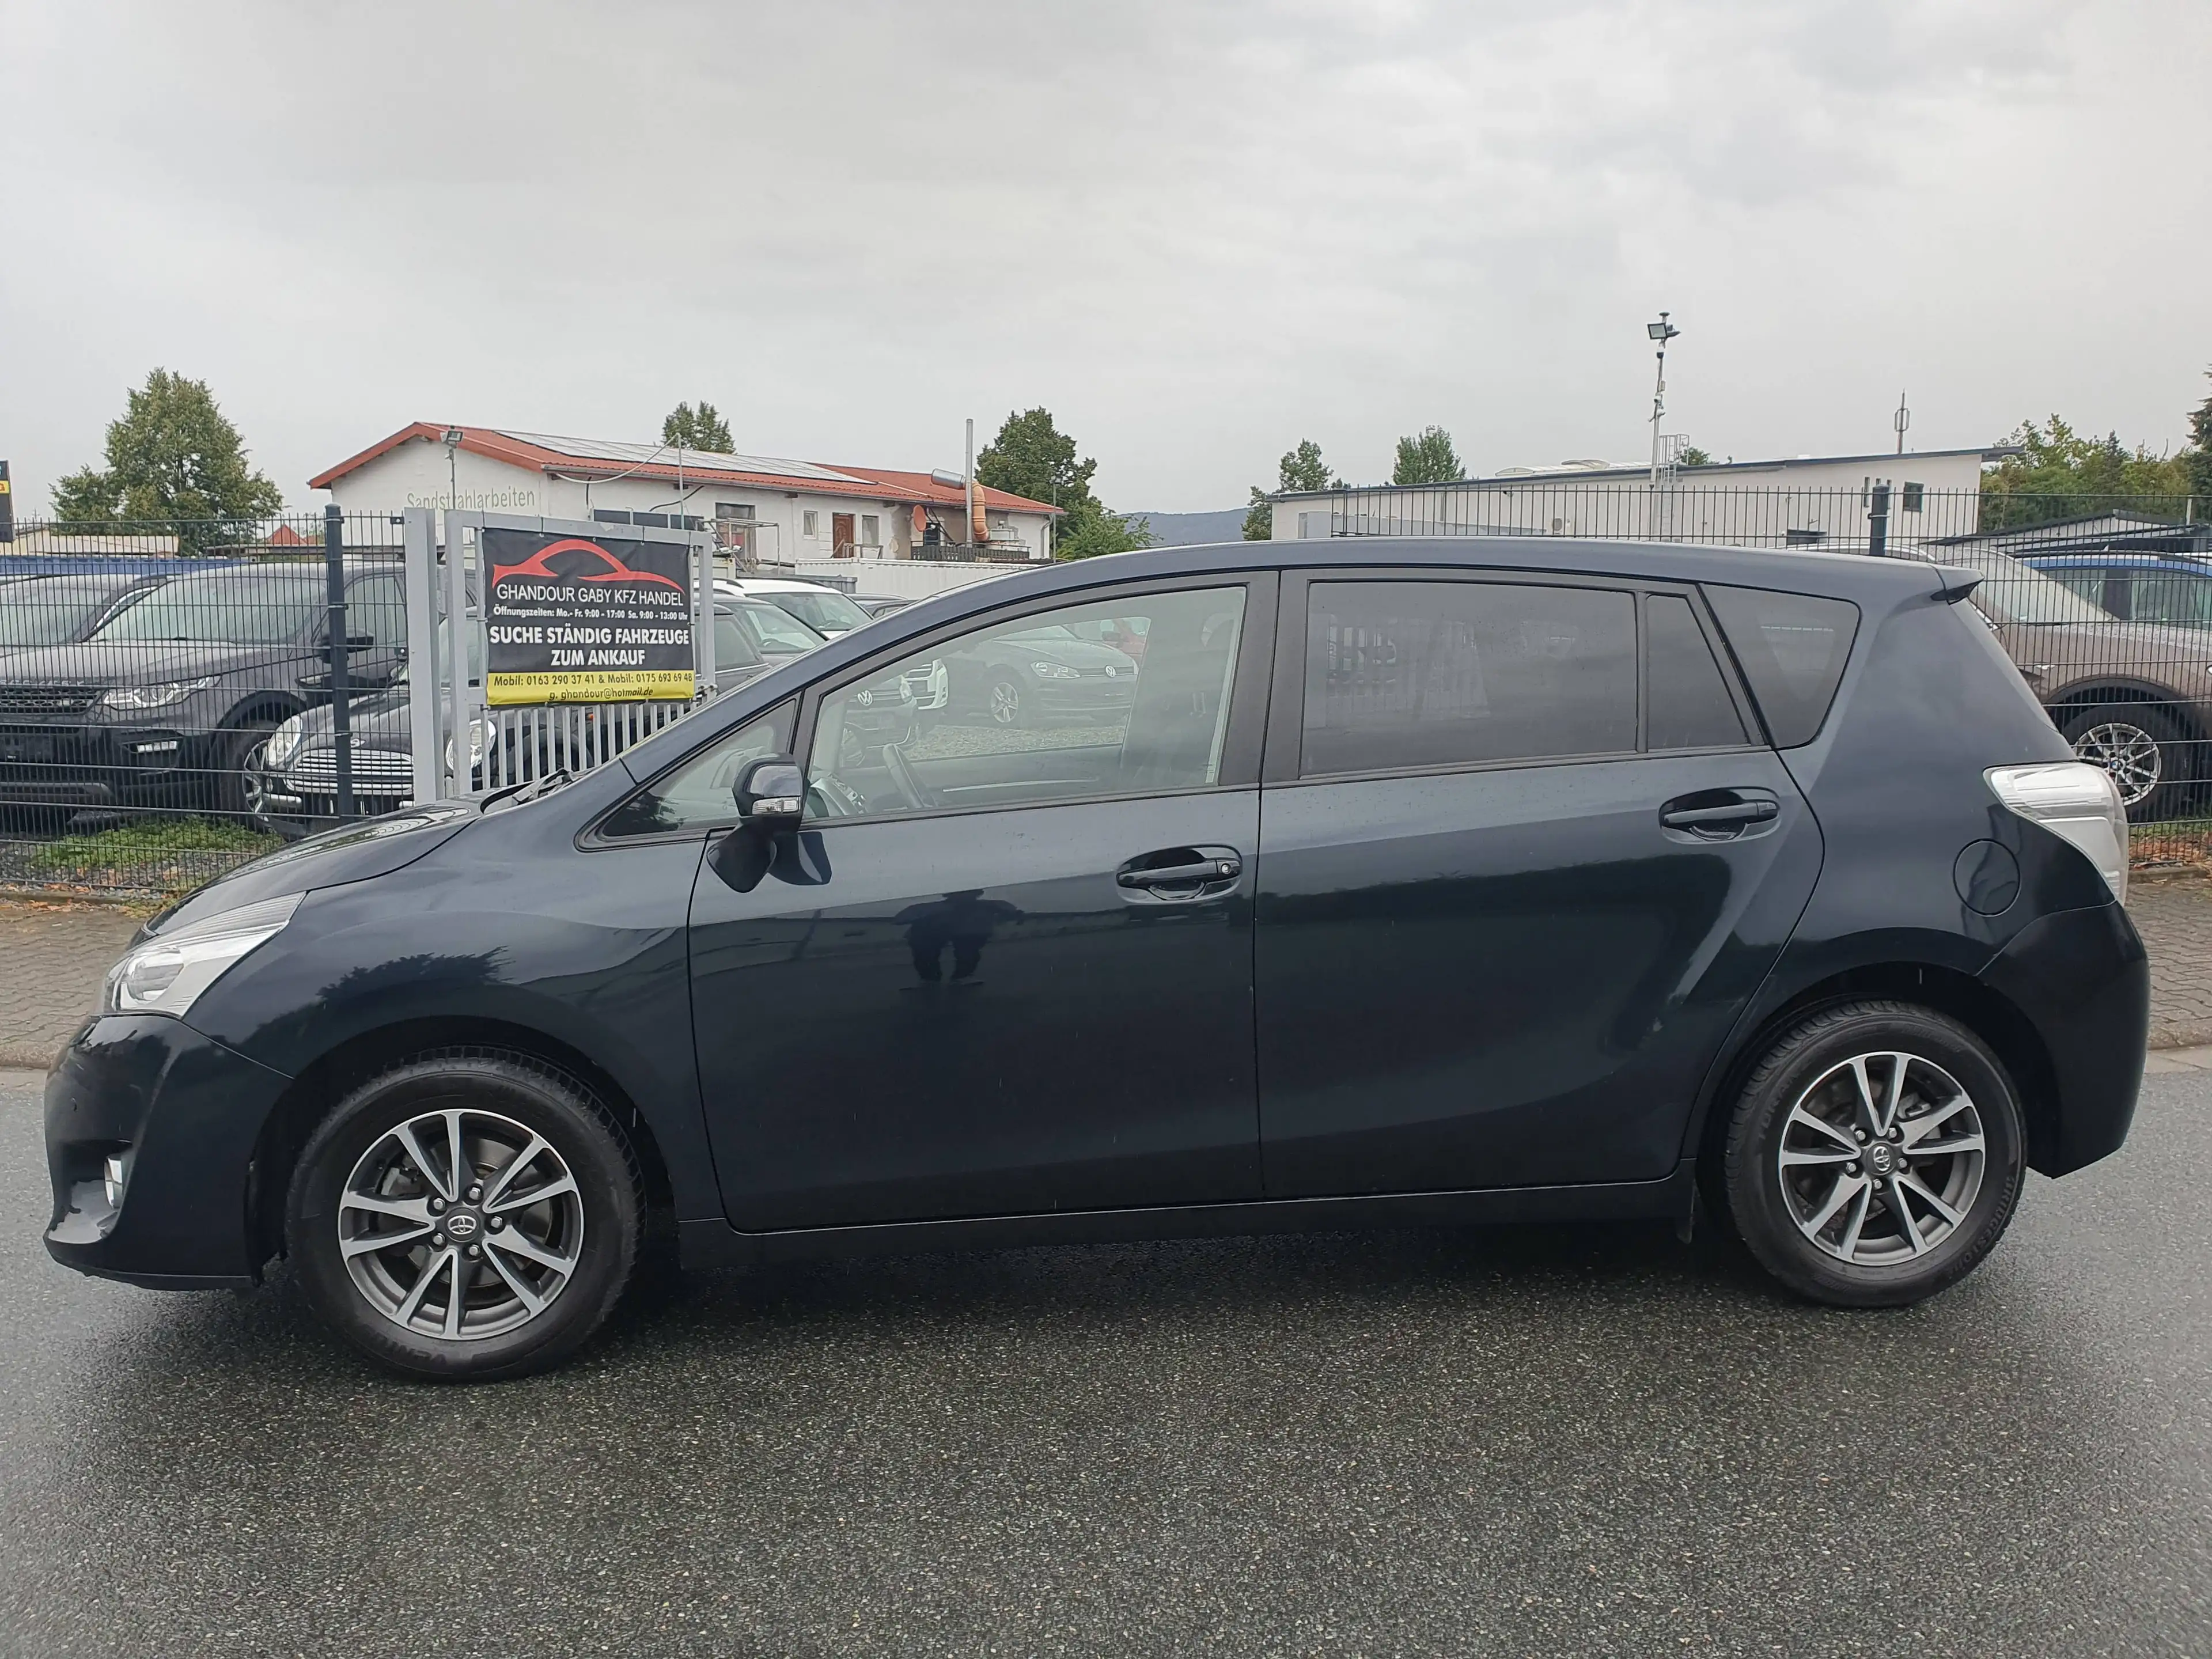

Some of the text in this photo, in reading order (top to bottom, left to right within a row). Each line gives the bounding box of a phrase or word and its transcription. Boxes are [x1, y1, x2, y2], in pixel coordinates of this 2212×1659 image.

[407, 486, 535, 510] Sandstahlarbeiten
[497, 584, 684, 606] GHANDOUR GABY KFZ HANDEL
[493, 604, 555, 618] Öffnungszeiten:
[574, 608, 584, 618] Fr.
[585, 609, 600, 618] 9:00
[607, 610, 625, 619] 17:00
[628, 611, 638, 619] Sa.
[639, 611, 654, 619] 9:00
[660, 612, 677, 620] 13:00
[678, 612, 688, 620] Uhr
[490, 623, 690, 645] SUCHE STÄNDIG FAHRZEUGE
[551, 649, 645, 666] ZUM ANKAUF
[494, 673, 692, 686] Mobil: 0163 290 37 41 & Mobil: 0175 693 69 48
[548, 686, 653, 701] g. ghandour@hotmail.de
